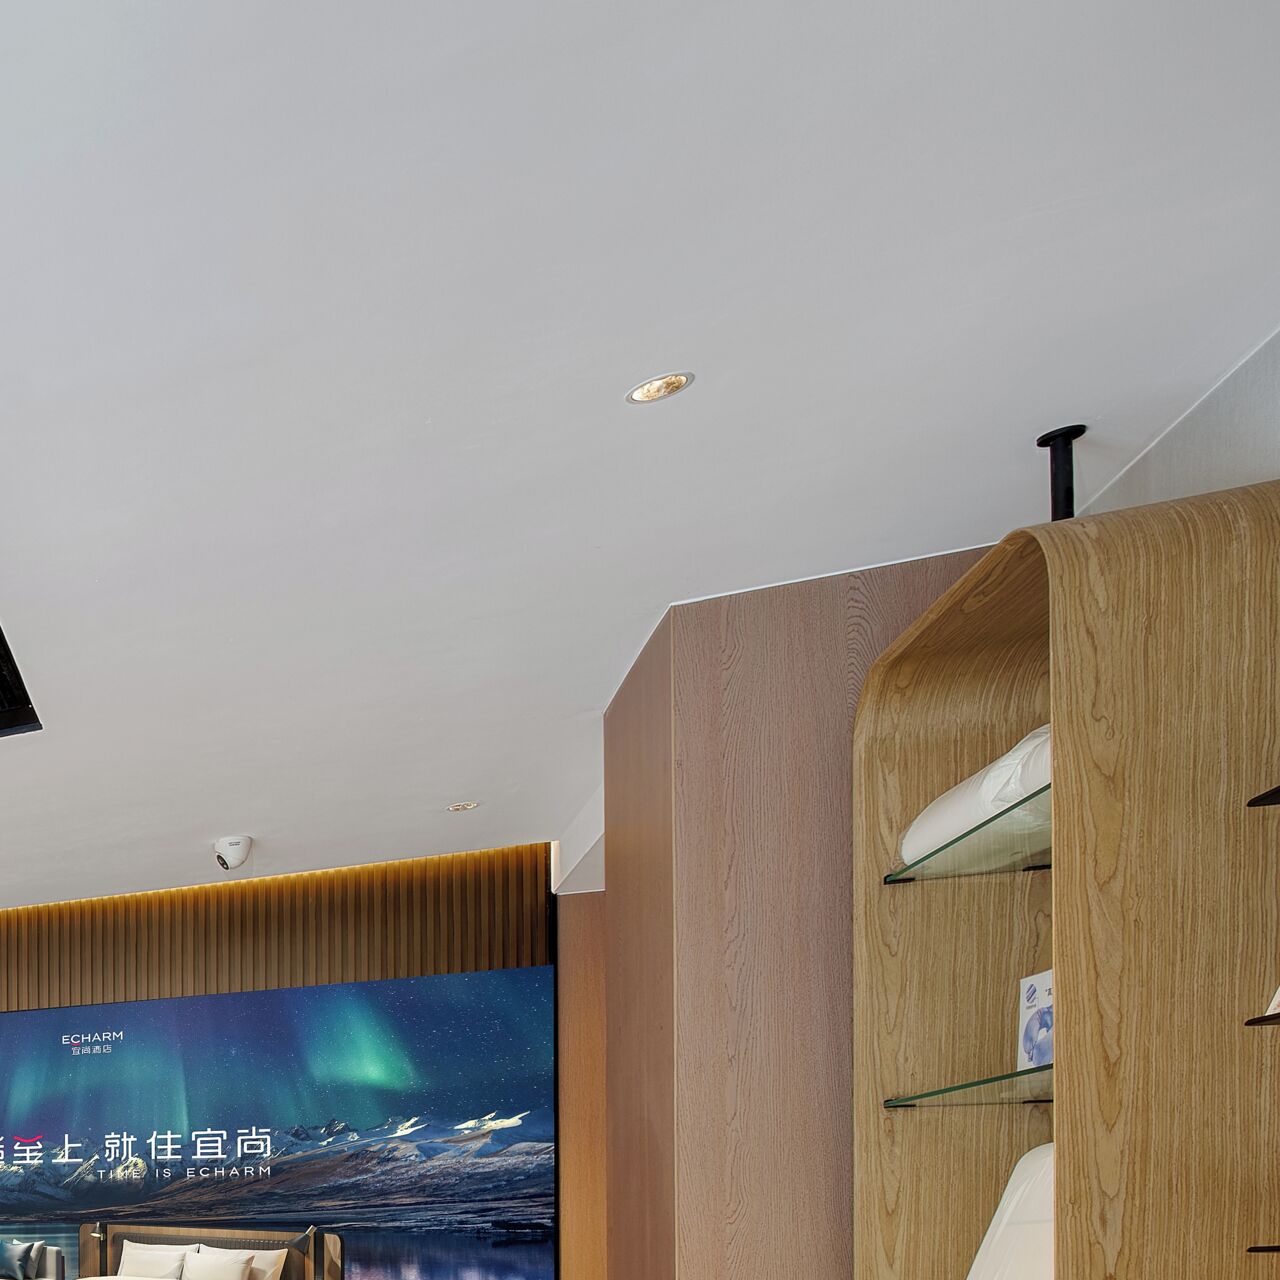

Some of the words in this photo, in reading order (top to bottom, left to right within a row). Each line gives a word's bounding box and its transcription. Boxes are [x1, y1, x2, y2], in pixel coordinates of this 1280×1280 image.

[61, 1030, 123, 1045] ECHARM
[71, 1044, 112, 1056] 宜尚酒店
[104, 1126, 271, 1167] 就住宜尚
[96, 1168, 141, 1181] TIME
[155, 1168, 172, 1179] IS
[186, 1165, 271, 1179] ECHARM
